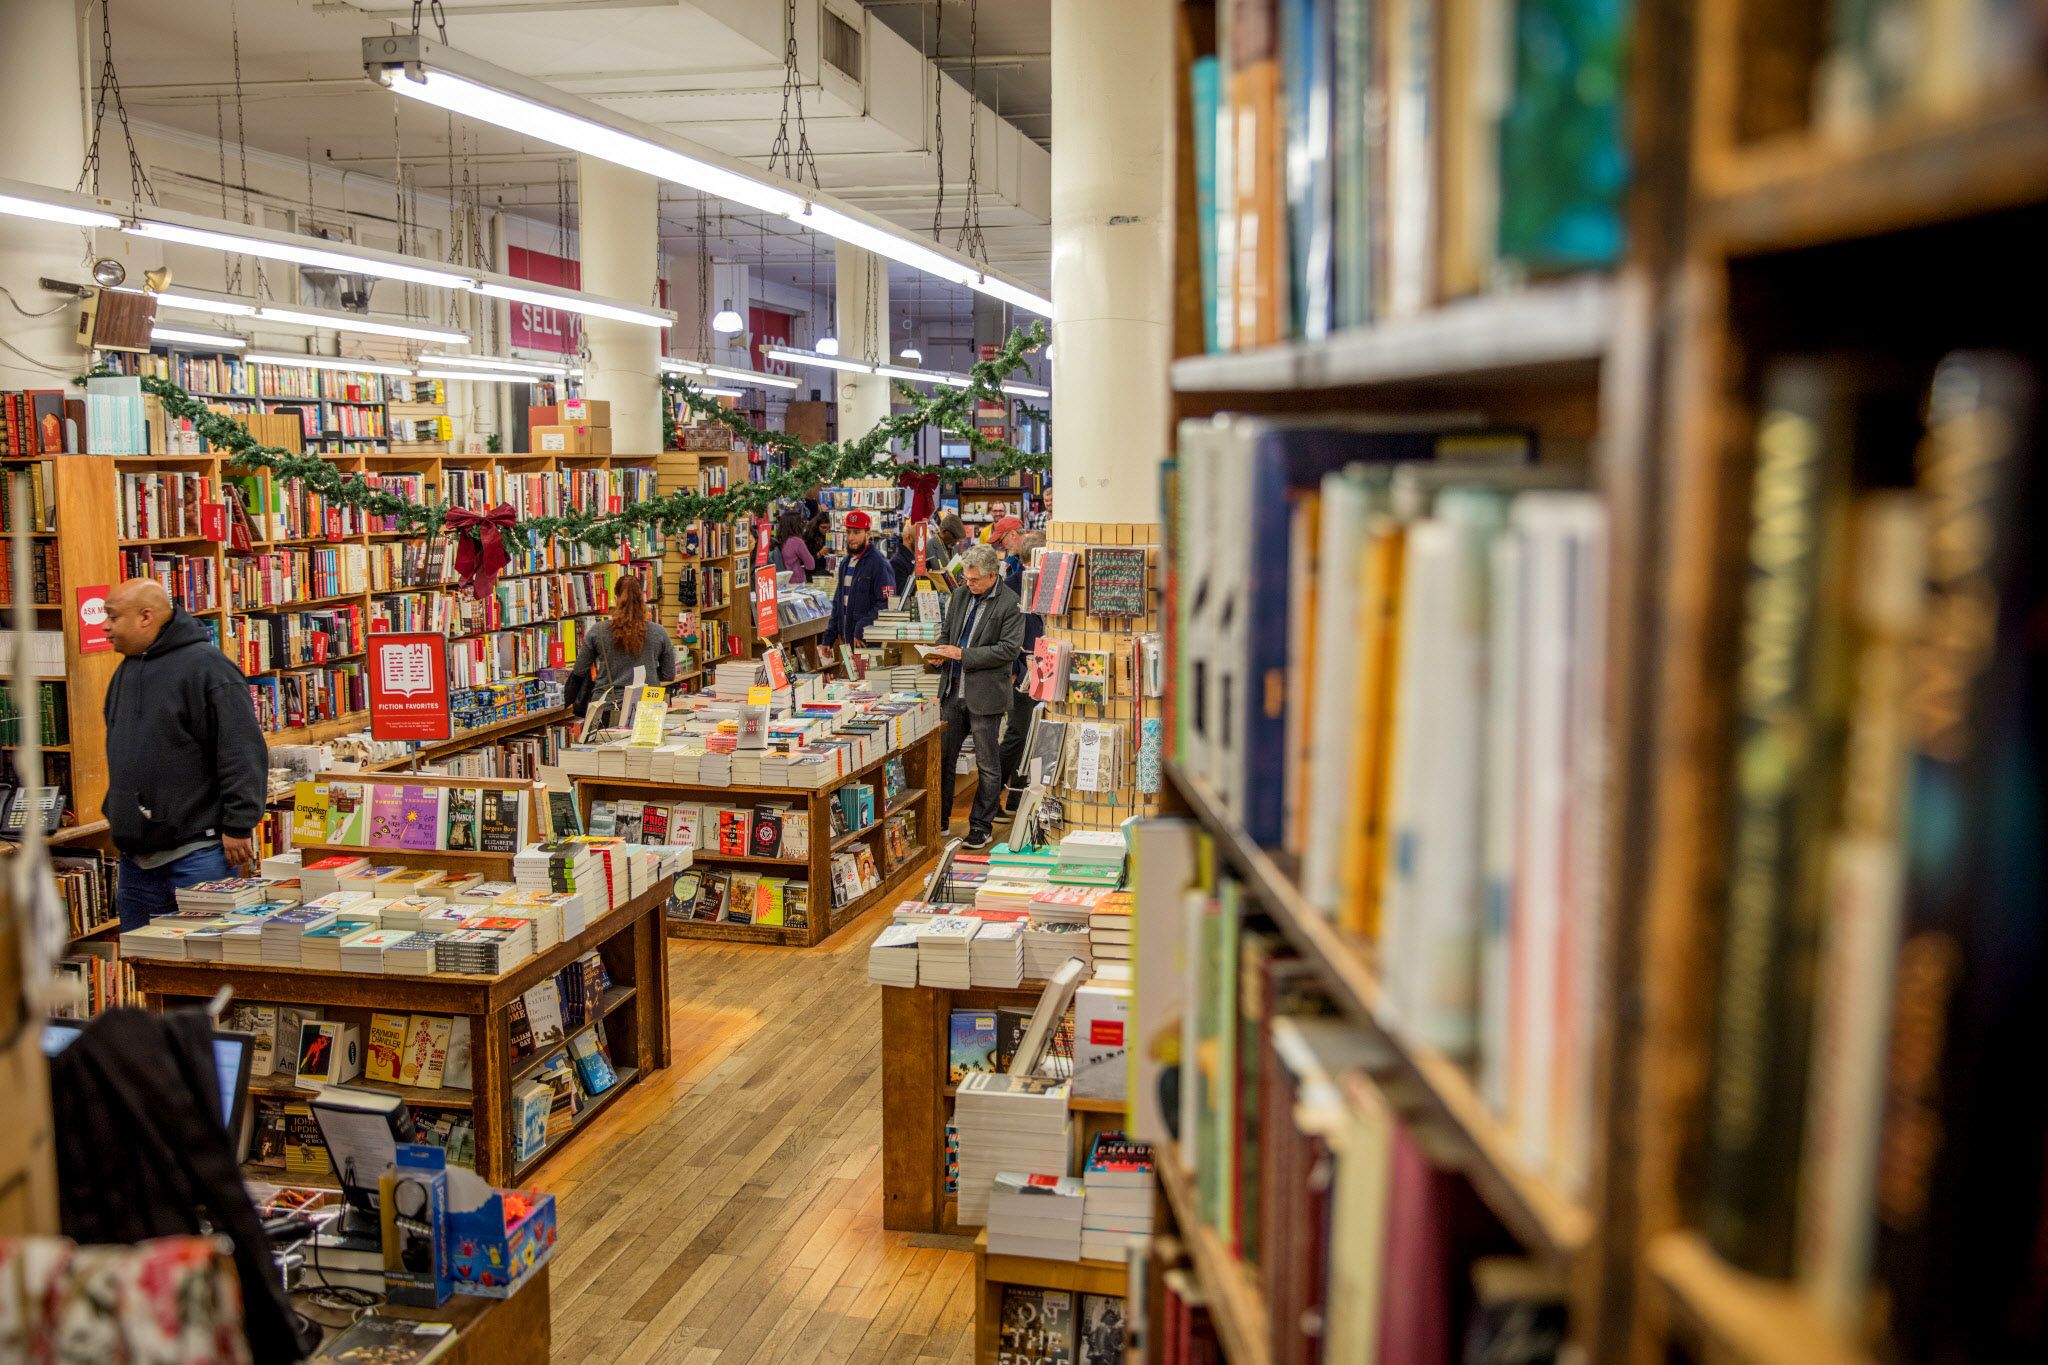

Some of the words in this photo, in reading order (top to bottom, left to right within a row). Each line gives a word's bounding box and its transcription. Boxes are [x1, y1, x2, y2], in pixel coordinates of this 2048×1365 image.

[522, 303, 562, 336] SELL
[83, 608, 96, 616] ASK
[646, 691, 659, 699] $10
[405, 702, 439, 710] FAVORITES
[643, 815, 667, 826] PRICE
[482, 825, 503, 833] Burgess
[503, 825, 517, 833] Boys
[509, 1001, 523, 1012] NG
[371, 1027, 400, 1040] RAYMOND
[510, 1031, 532, 1045] ILLIAM
[371, 1035, 401, 1050] CHANDLER
[290, 1125, 319, 1133] UPDIK
